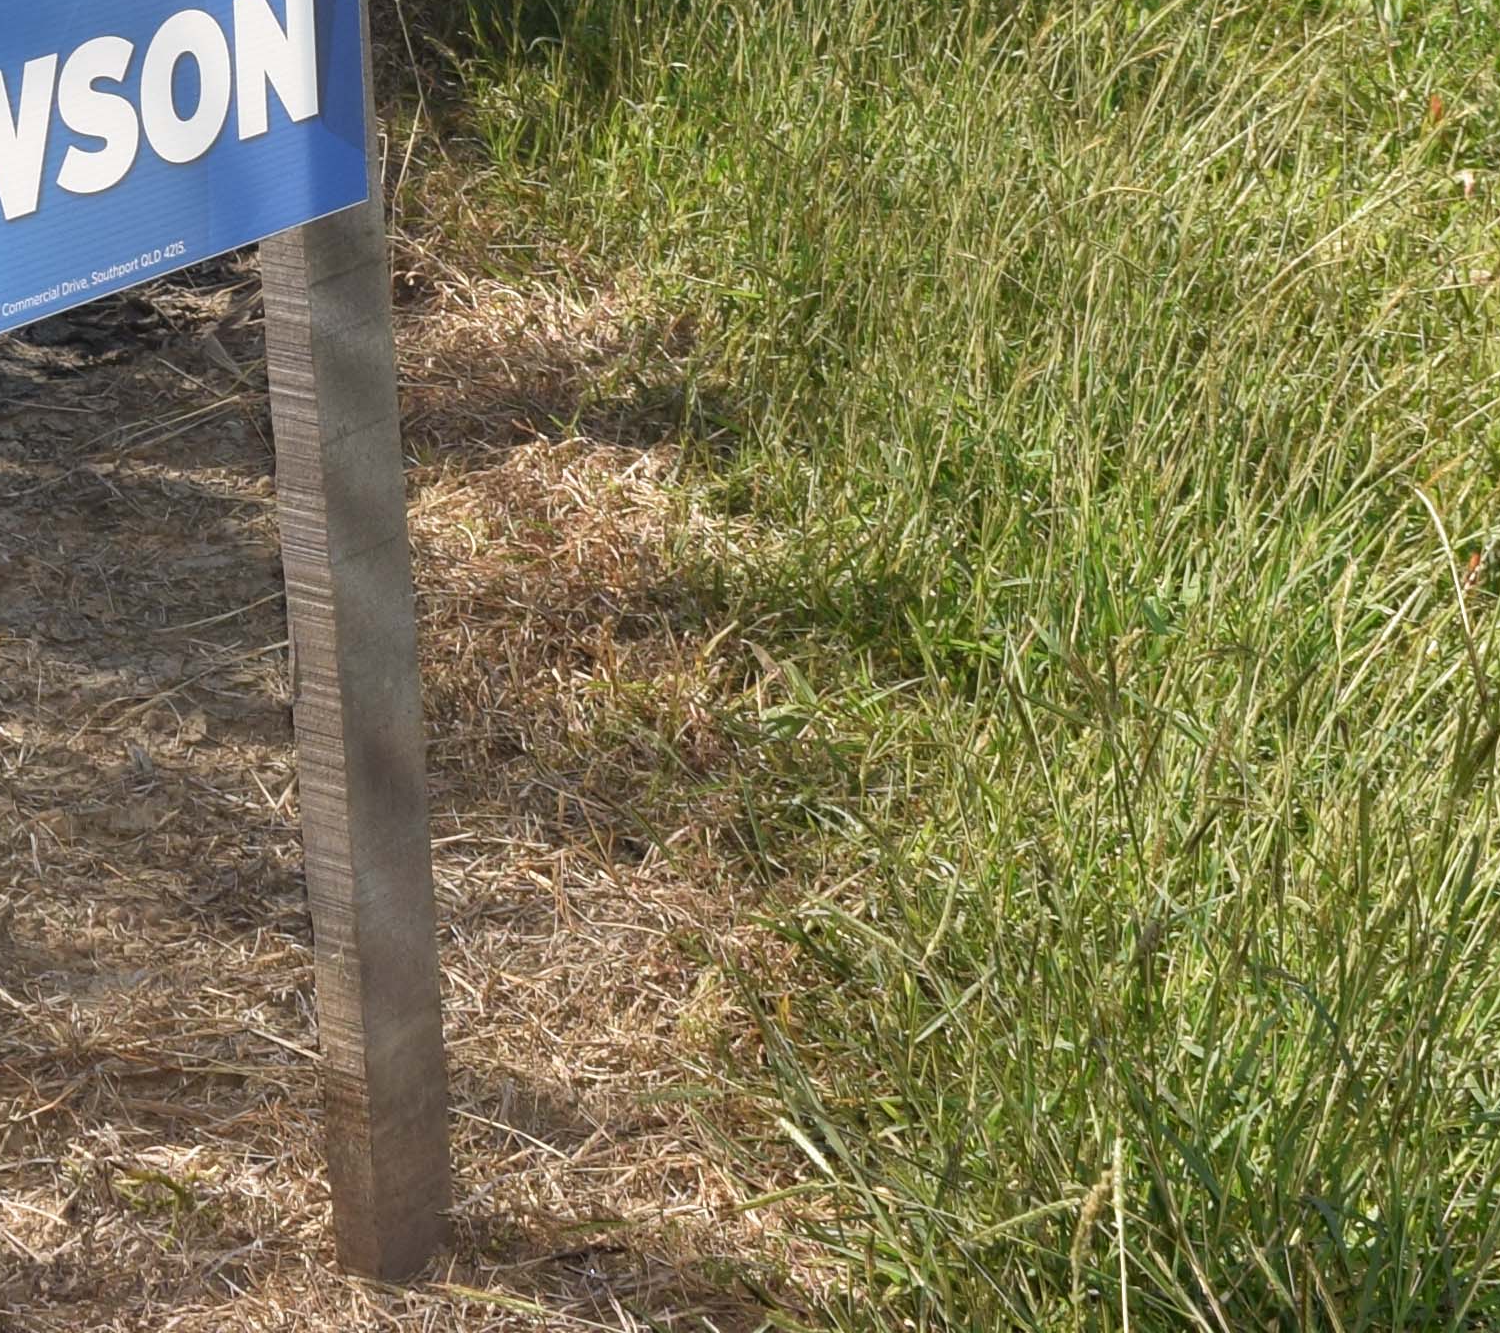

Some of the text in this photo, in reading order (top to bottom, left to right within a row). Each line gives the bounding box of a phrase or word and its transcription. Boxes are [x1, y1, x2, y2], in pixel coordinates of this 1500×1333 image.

[1, 288, 60, 316] Commercial
[91, 259, 139, 286] Southport
[141, 248, 162, 268] QLD
